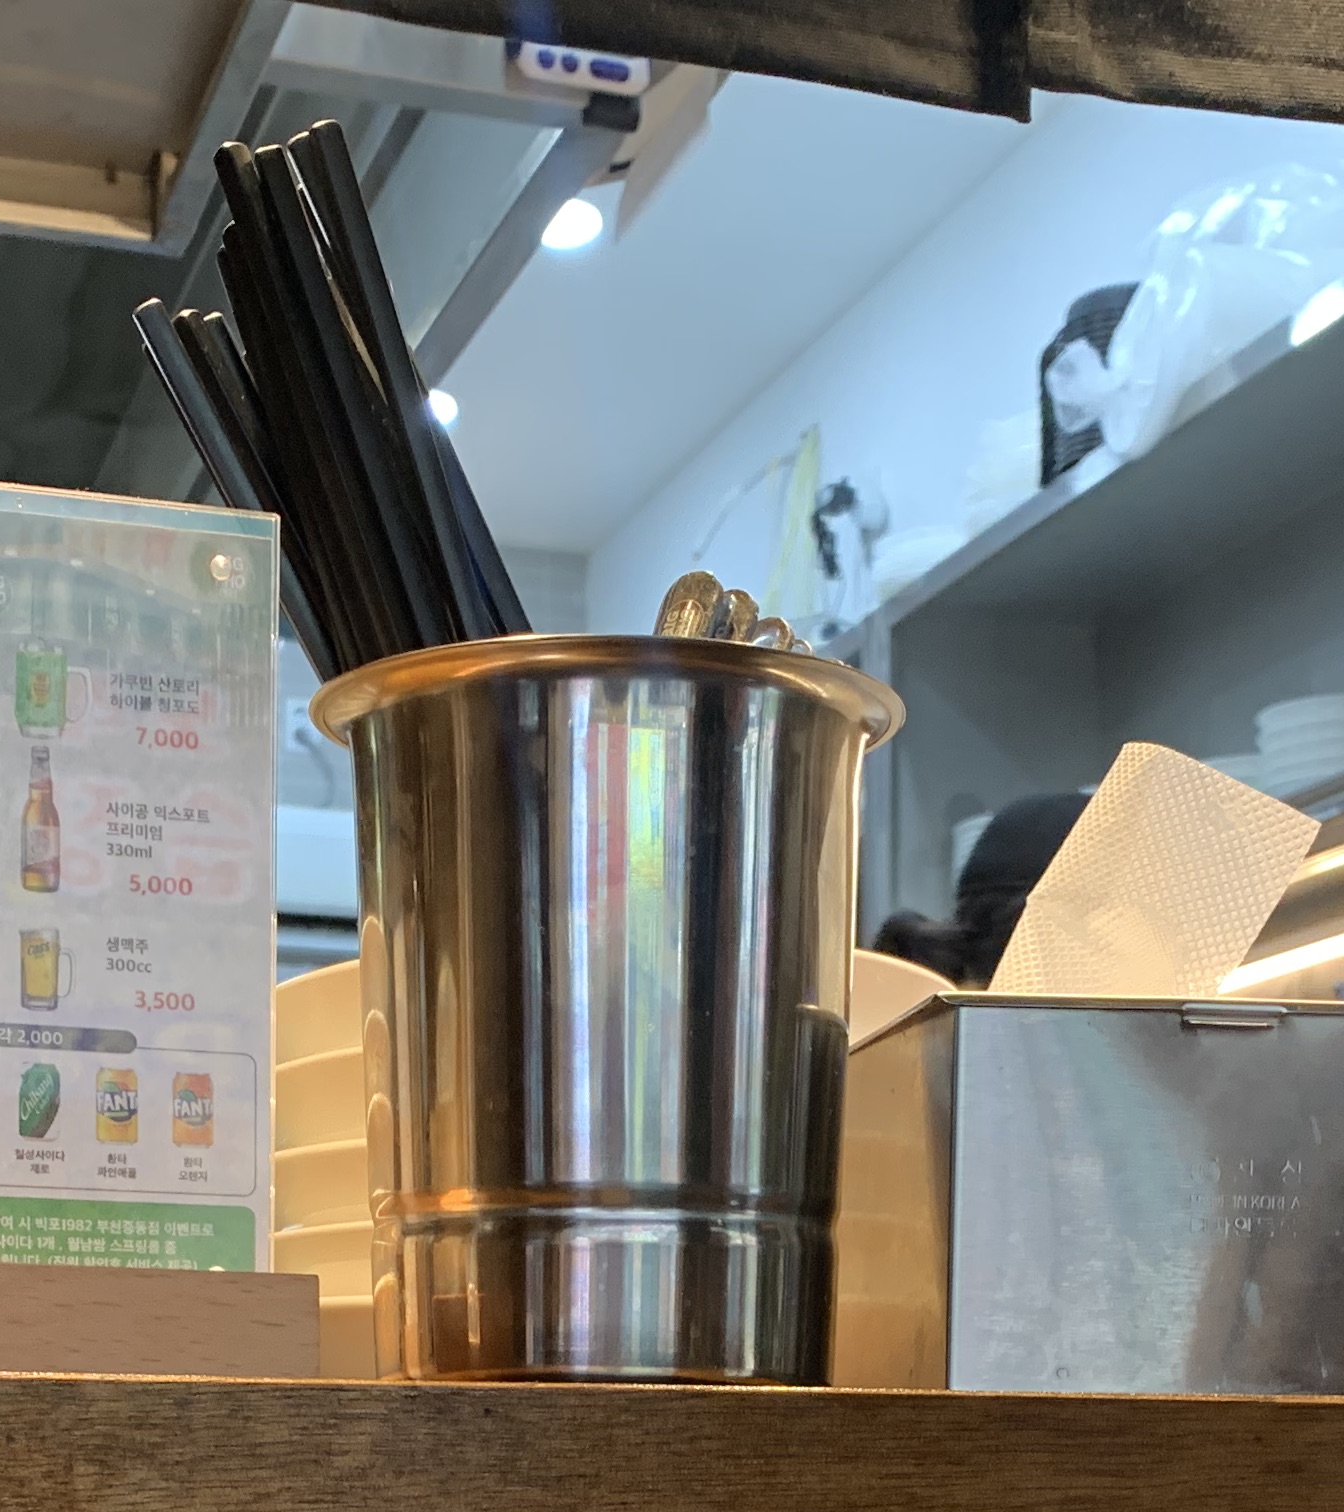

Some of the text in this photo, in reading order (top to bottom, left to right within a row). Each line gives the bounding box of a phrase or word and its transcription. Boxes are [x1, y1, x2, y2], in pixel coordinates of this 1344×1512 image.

[110, 673, 200, 696] 가쿠빈 산토리
[110, 693, 152, 711] 하이볼
[136, 726, 199, 750] 7,000
[106, 801, 211, 823] 사이공 익스포트
[106, 823, 163, 841] 프리미엄
[106, 843, 153, 859] 330ml
[129, 874, 193, 896] 5,000
[106, 936, 150, 955] 생맥주
[105, 957, 153, 974] 300cc
[134, 989, 196, 1013] 3,500
[17, 1029, 64, 1046] 2,000
[18, 1216, 31, 1230] 시
[35, 1217, 92, 1232] 빅포1982
[164, 1222, 215, 1237] 이벤트로
[37, 1237, 55, 1251] 1개
